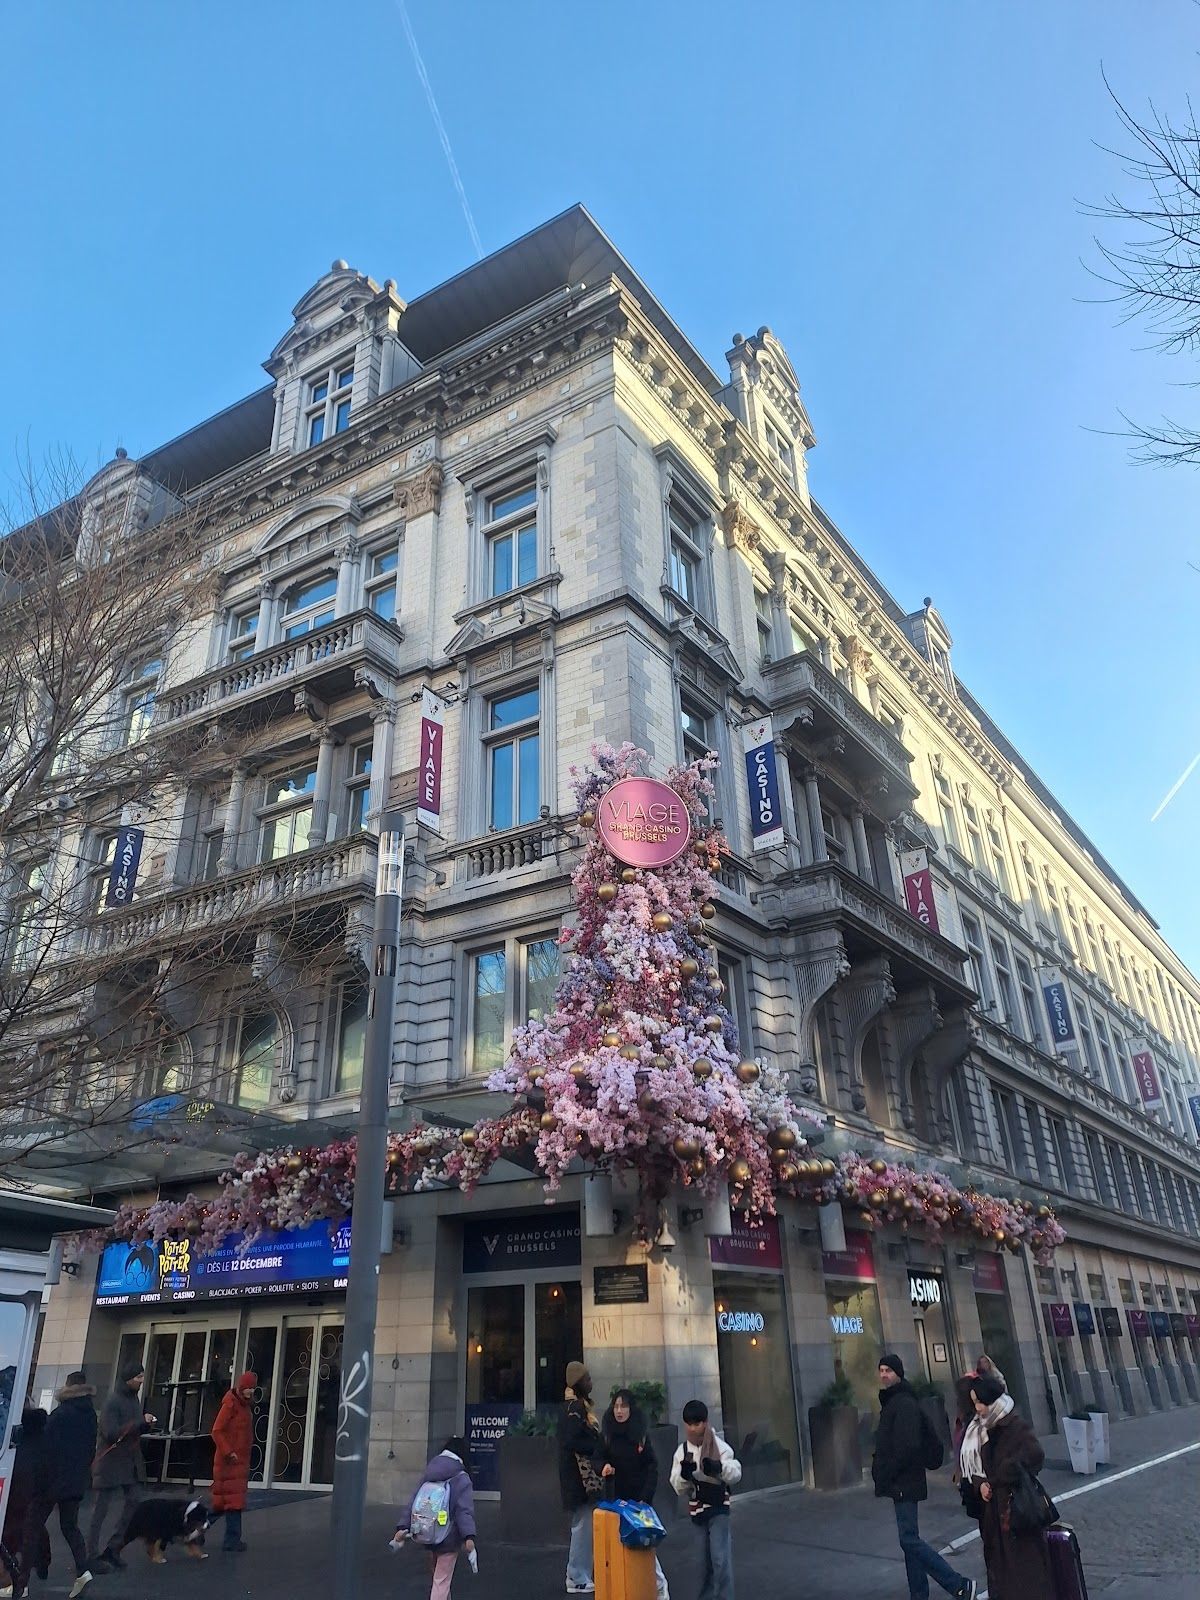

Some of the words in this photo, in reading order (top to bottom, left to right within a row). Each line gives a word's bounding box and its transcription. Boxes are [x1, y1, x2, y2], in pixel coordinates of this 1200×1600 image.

[425, 725, 437, 802] VIAGE
[754, 751, 773, 824] CASINO
[608, 799, 681, 824] VIAGE
[609, 821, 643, 833] GRAND
[645, 824, 681, 835] CASINO
[623, 830, 668, 843] BRUSSELS
[114, 832, 137, 900] CASINO
[911, 876, 930, 924] VIAG
[1050, 988, 1069, 1036] CASINO
[1137, 1056, 1154, 1096] VIAGE
[506, 1231, 541, 1242] GRAND
[543, 1228, 581, 1240] CASINO
[732, 1227, 749, 1239] RAND
[750, 1230, 771, 1241] CASINO
[163, 1239, 190, 1256] POTTED
[273, 1242, 294, 1251] PARODIE
[506, 1241, 557, 1254] BRUSSELS
[729, 1238, 759, 1250] BRUSSELS
[159, 1253, 191, 1276] POTTER
[206, 1261, 221, 1273] DÈS
[222, 1261, 230, 1272] LE
[231, 1260, 239, 1271] 12
[240, 1256, 283, 1270] DÉCEMBRE
[96, 1295, 130, 1305] RESTAURANT
[140, 1293, 161, 1302] EVENTS
[173, 1291, 196, 1300] CASINO
[208, 1287, 239, 1297] BLACKJACK
[244, 1286, 262, 1294] POKER
[268, 1283, 294, 1292] ROULETTE
[301, 1281, 319, 1290] SLOTS
[333, 1278, 348, 1288] BAR
[910, 1277, 941, 1303] ASINO
[719, 1311, 765, 1332] CASINO
[830, 1315, 864, 1334] VIAGE
[471, 1416, 509, 1426] WELCOME
[470, 1429, 481, 1439] AT
